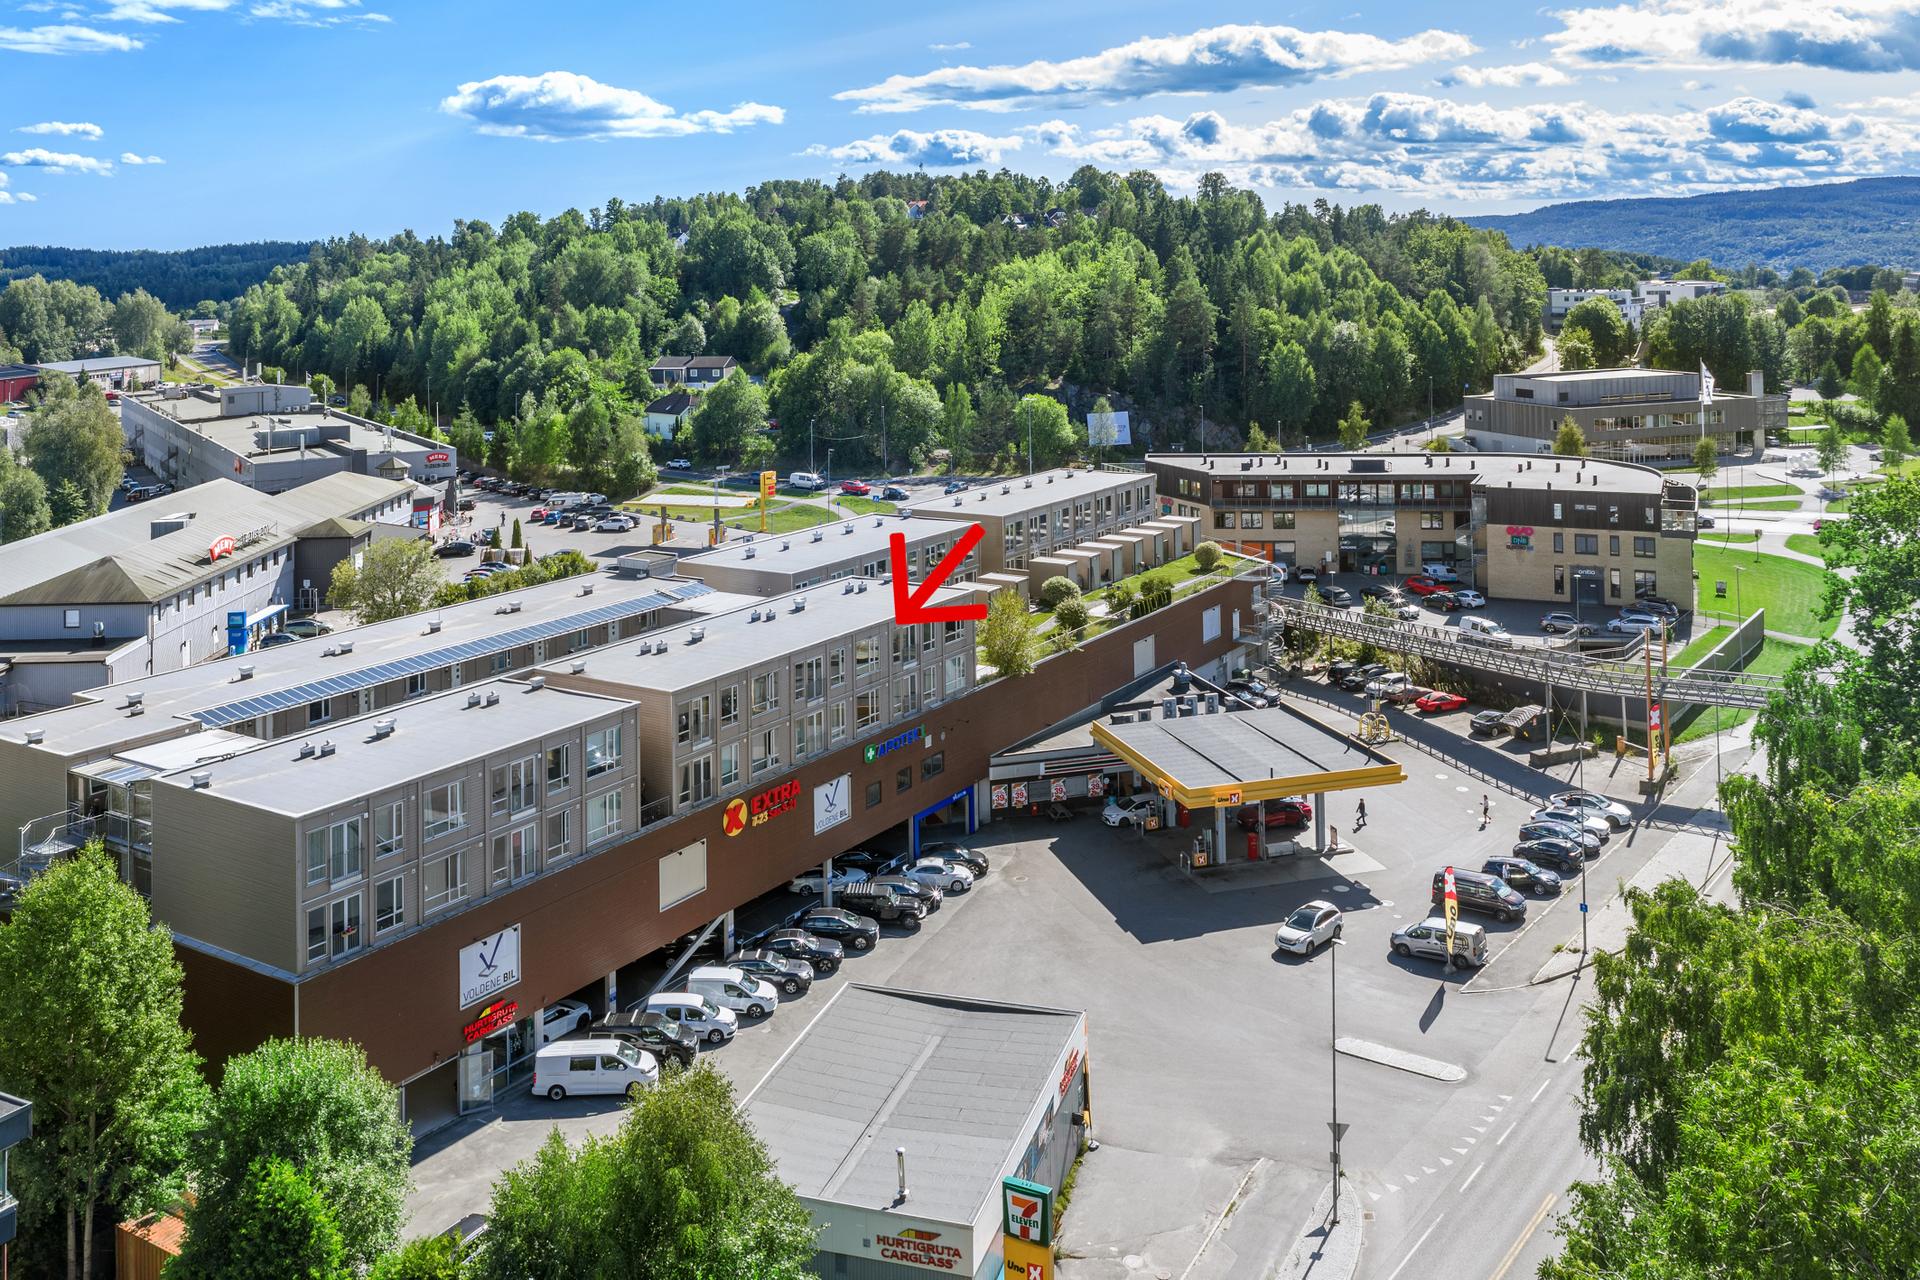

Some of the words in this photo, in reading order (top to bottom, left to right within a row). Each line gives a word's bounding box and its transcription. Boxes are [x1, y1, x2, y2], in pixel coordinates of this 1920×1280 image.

[428, 453, 448, 461] MENY
[213, 539, 234, 557] MENY
[1512, 536, 1527, 545] DNB
[876, 726, 921, 758] APOTEK
[751, 780, 800, 815] EXTRA
[1015, 791, 1024, 799] 39
[815, 811, 839, 830] VOLDENE
[840, 808, 848, 819] BIL
[463, 975, 501, 1001] VOLDENE
[503, 969, 516, 982] BIL
[464, 1001, 519, 1035] HURTIGRUTA
[1011, 1194, 1038, 1240] 7
[876, 1234, 962, 1259] HURTIGRUTA
[1007, 1259, 1025, 1274] Uno
